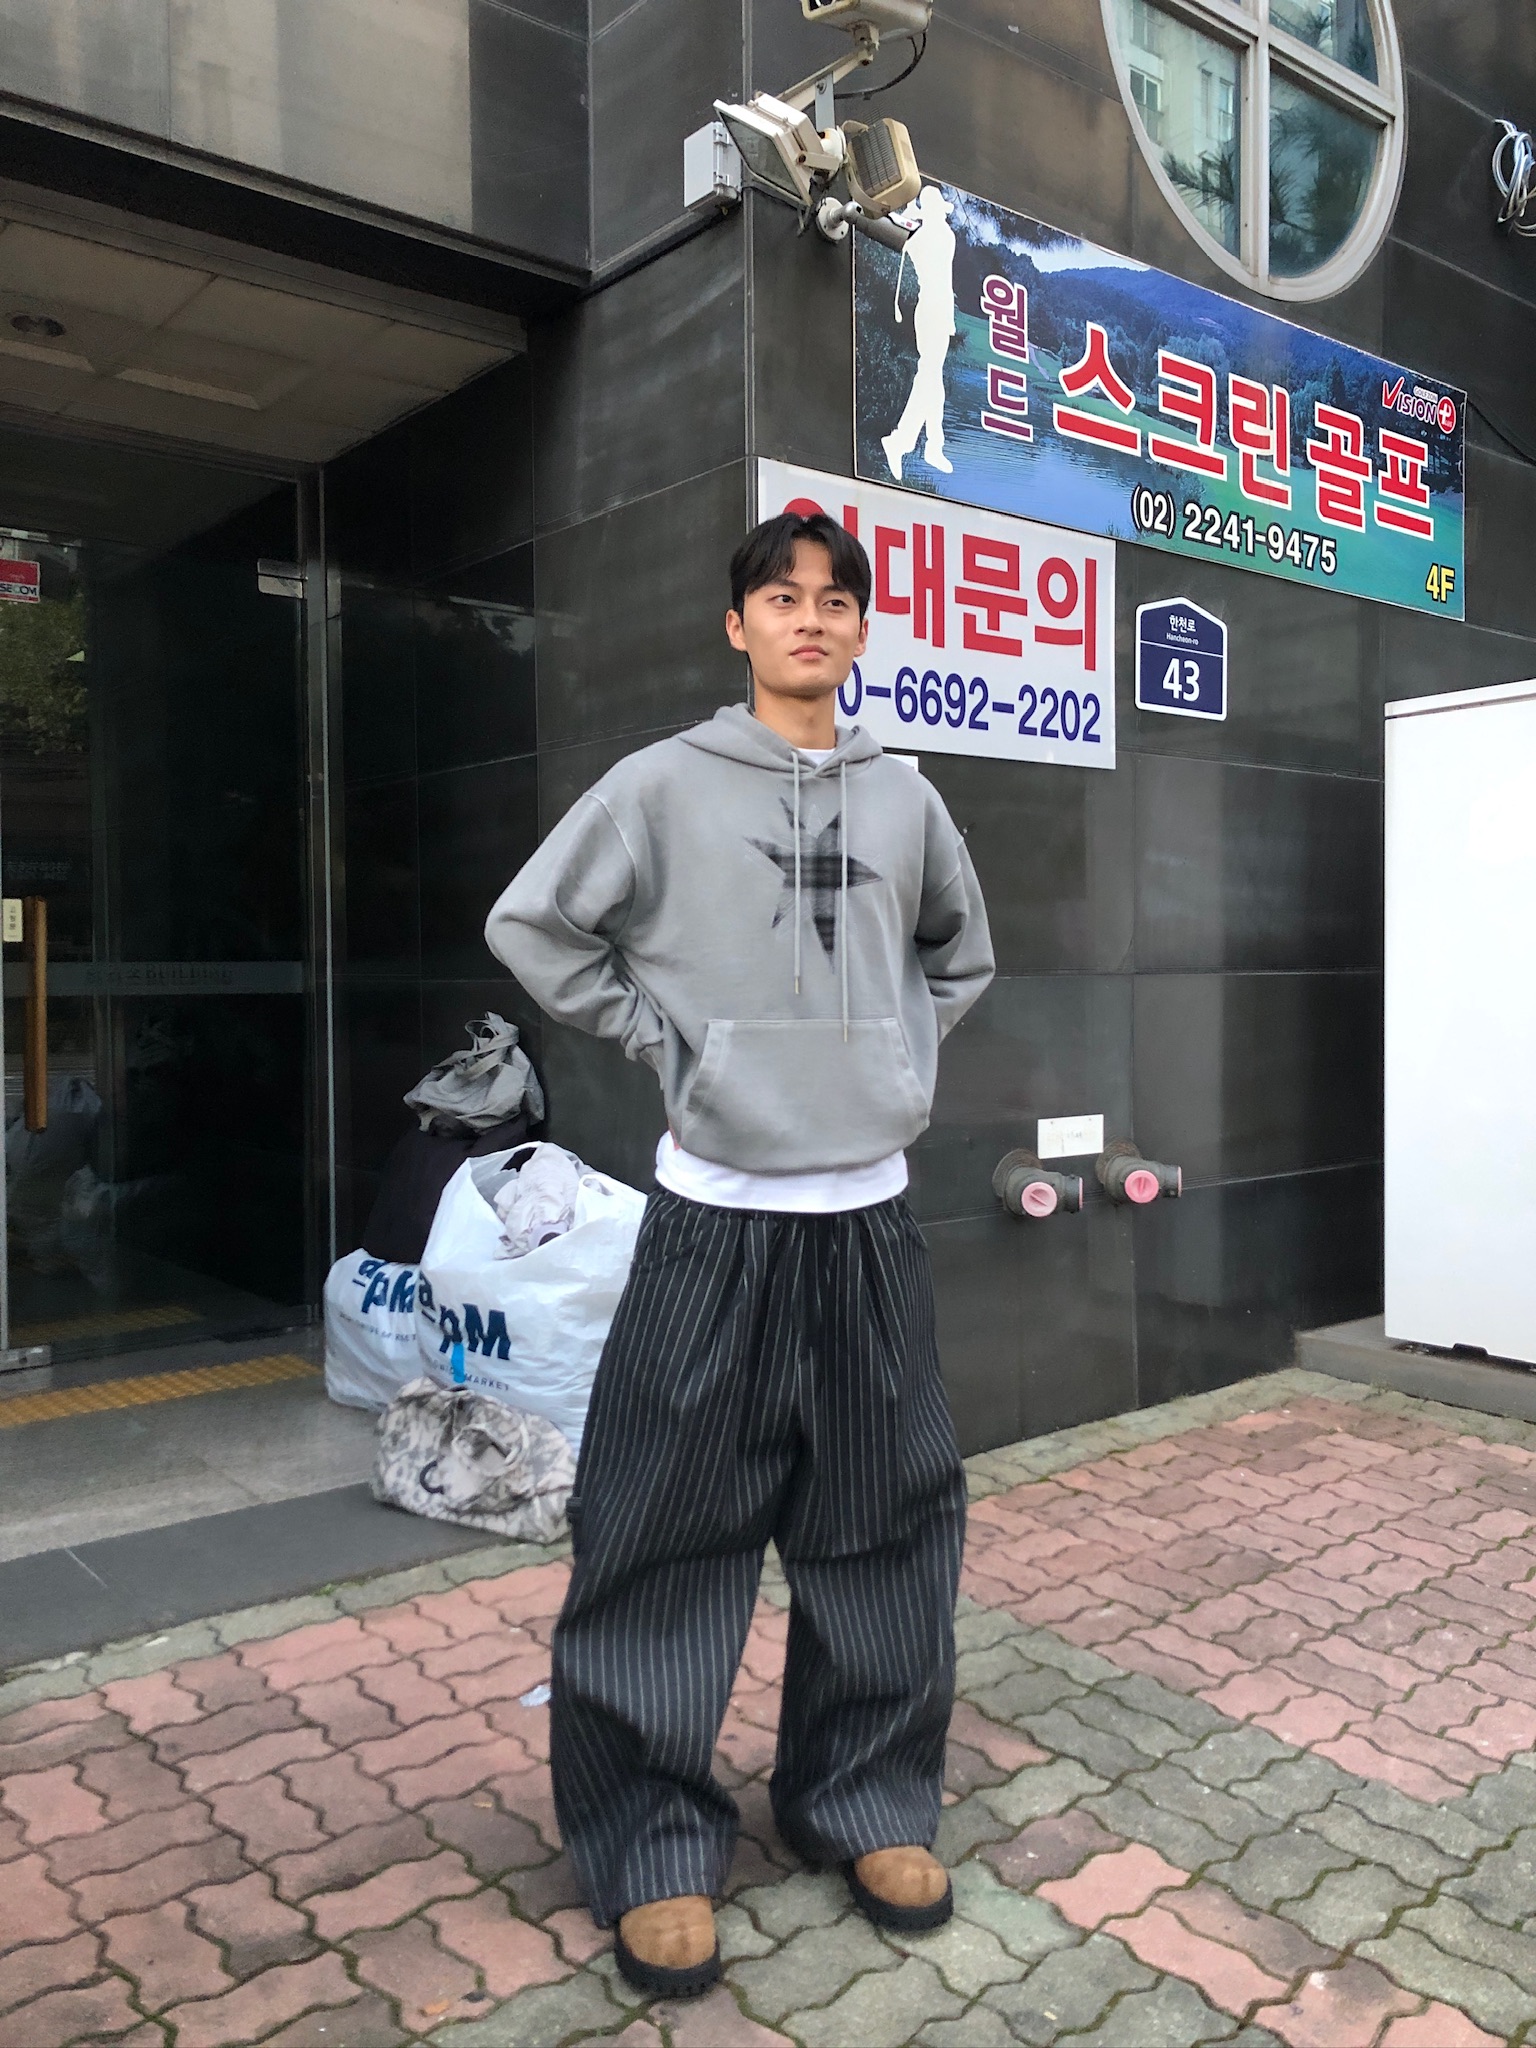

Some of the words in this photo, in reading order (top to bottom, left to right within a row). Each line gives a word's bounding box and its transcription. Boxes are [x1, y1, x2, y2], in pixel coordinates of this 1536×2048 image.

[980, 274, 1034, 442] 월드
[1382, 376, 1437, 425] VISION
[1414, 387, 1437, 402] GOLFZON
[1131, 484, 1177, 540] (02)
[1183, 501, 1338, 576] 2241-9475
[783, 497, 1096, 671] 대문의
[1425, 562, 1455, 603] 4F
[1166, 632, 1199, 645] Hancheon-ro
[1169, 615, 1196, 633] 한천로
[1163, 658, 1201, 702] 43
[464, 1373, 510, 1391] MARKET
